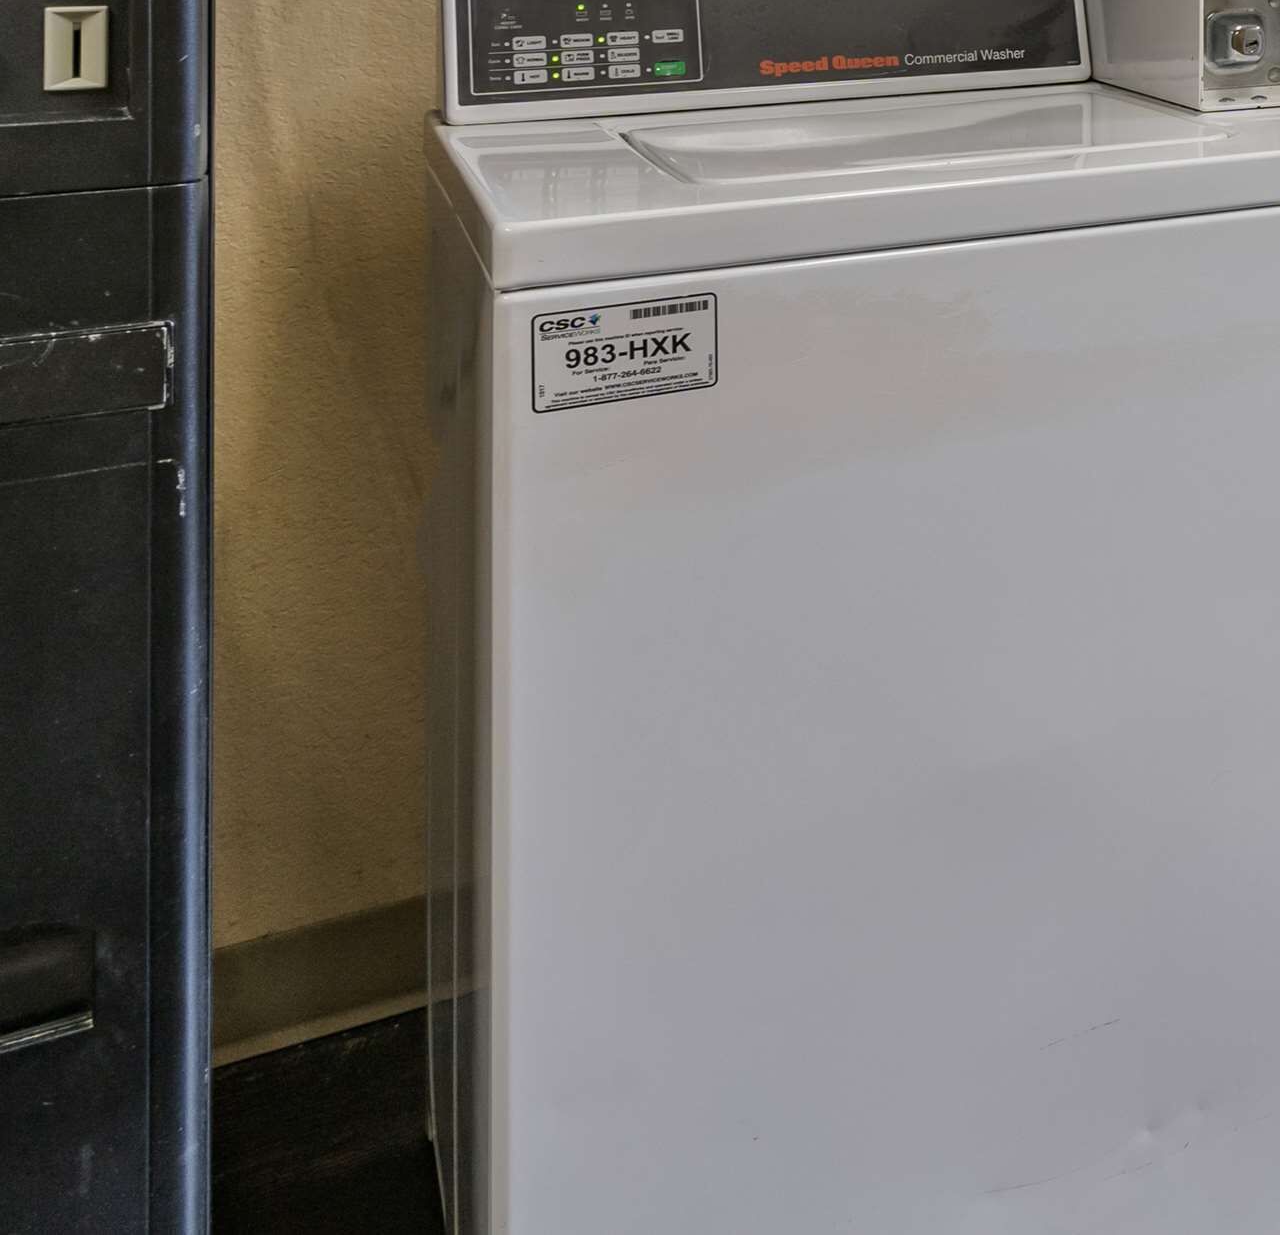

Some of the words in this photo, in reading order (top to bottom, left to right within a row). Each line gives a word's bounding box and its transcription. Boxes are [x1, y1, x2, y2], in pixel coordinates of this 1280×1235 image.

[760, 56, 829, 77] Speed
[832, 54, 900, 71] Queen
[904, 49, 978, 66] Commercial
[980, 48, 1025, 61] Washer
[539, 316, 586, 333] CSC
[565, 332, 692, 368] 983-HXK
